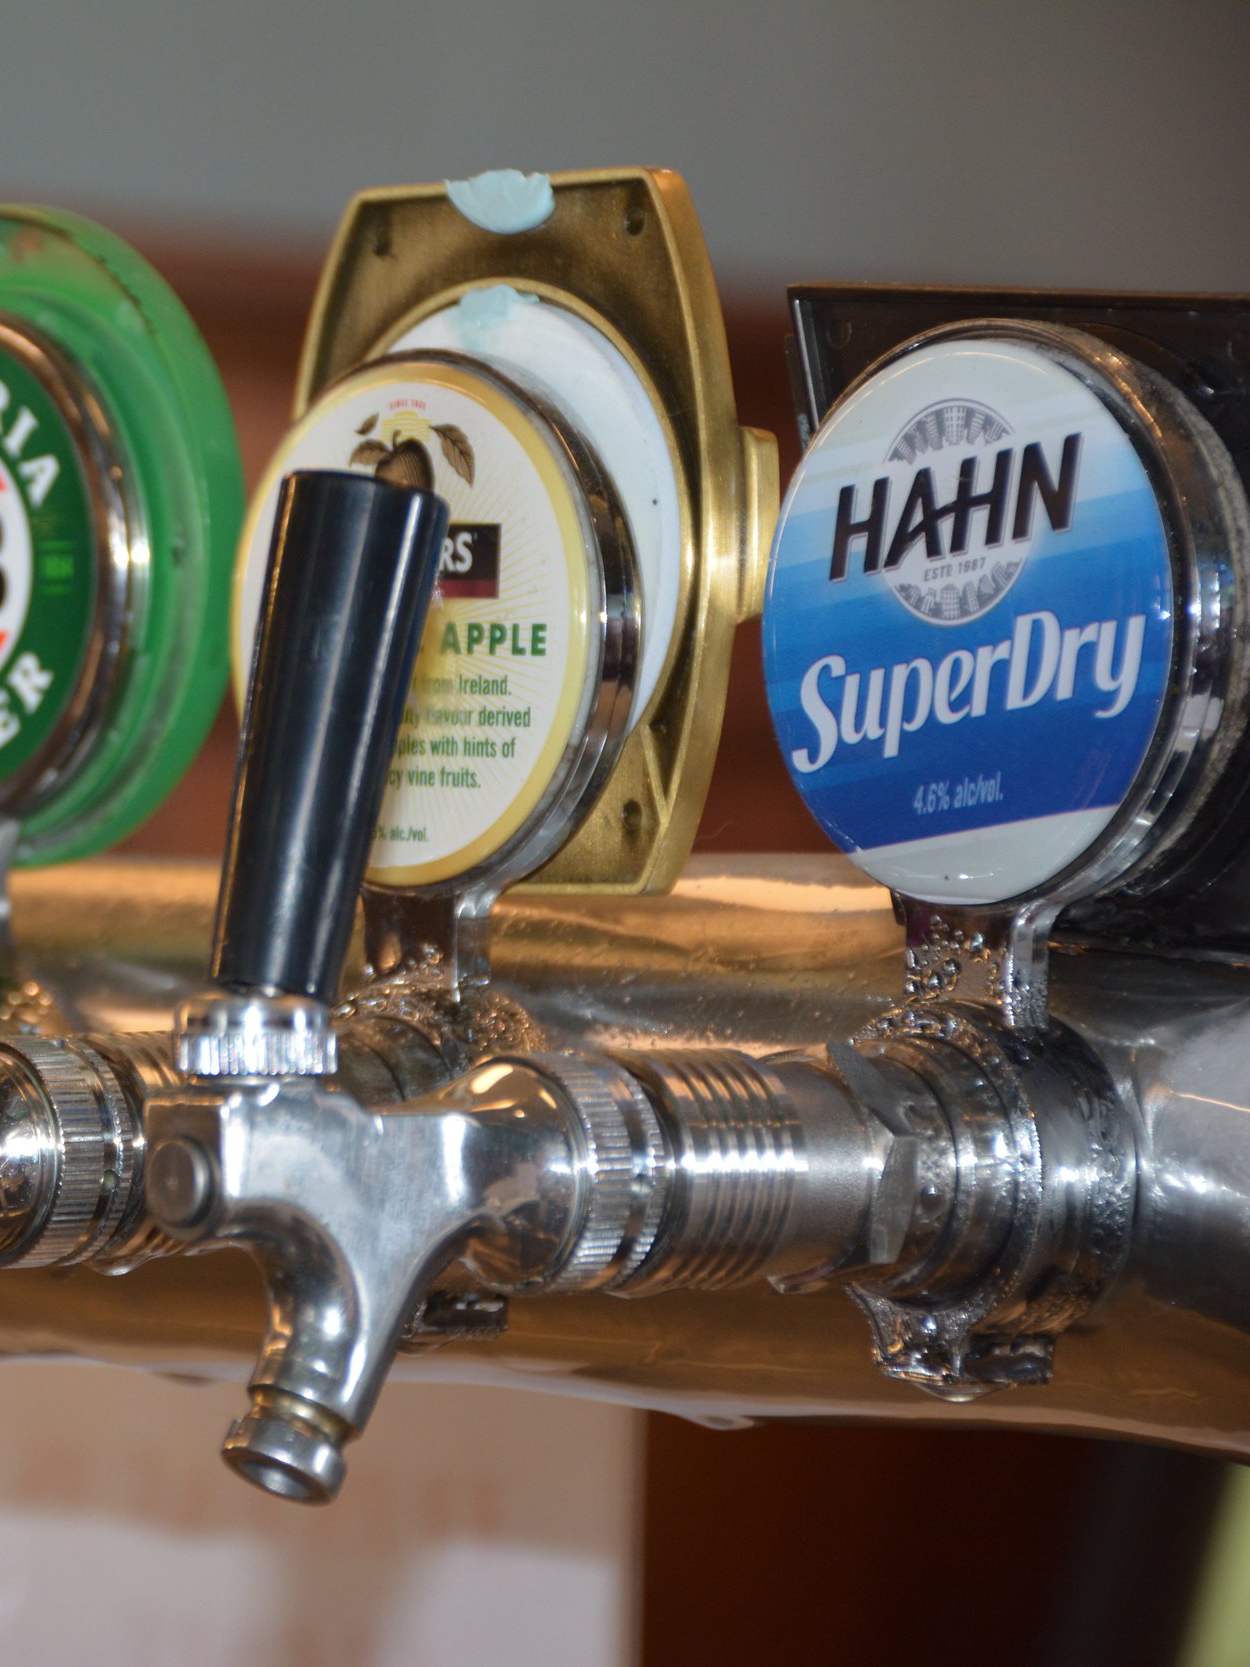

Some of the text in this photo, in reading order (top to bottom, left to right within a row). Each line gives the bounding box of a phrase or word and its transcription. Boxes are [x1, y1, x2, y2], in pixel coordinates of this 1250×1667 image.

[829, 431, 1083, 583] HAHN
[958, 557, 987, 575] 1987
[439, 621, 548, 657] APPLE
[458, 673, 512, 696] Ireland.
[791, 610, 1147, 774] SuperDry
[478, 705, 532, 729] derived
[430, 736, 459, 756] with
[463, 736, 497, 758] hints
[501, 737, 517, 758] of
[407, 765, 436, 787] vine
[440, 766, 481, 789] fruits.
[913, 770, 1004, 815] 4.6% alc/vol.
